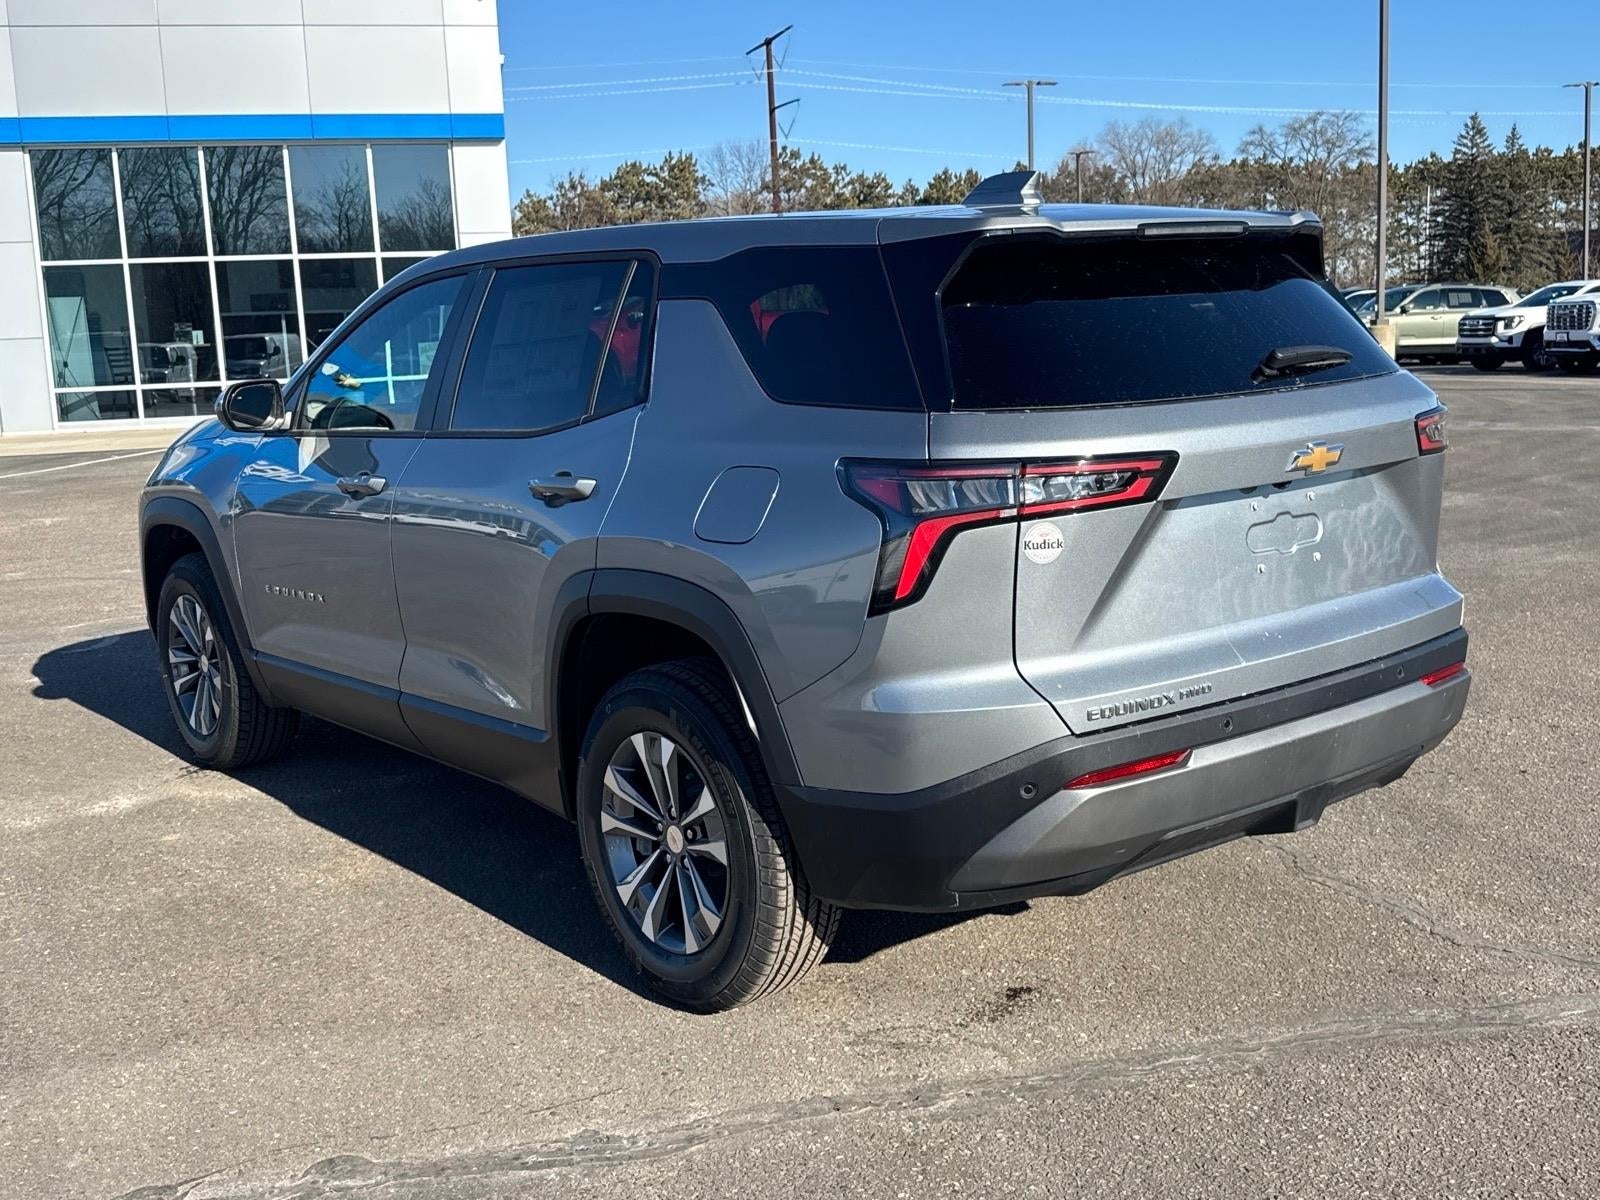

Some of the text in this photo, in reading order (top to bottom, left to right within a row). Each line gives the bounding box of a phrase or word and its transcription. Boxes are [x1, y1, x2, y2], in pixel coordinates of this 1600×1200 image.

[1024, 538, 1064, 551] Kudick
[264, 584, 326, 604] EQUINOX
[1086, 690, 1176, 722] EQUINOX
